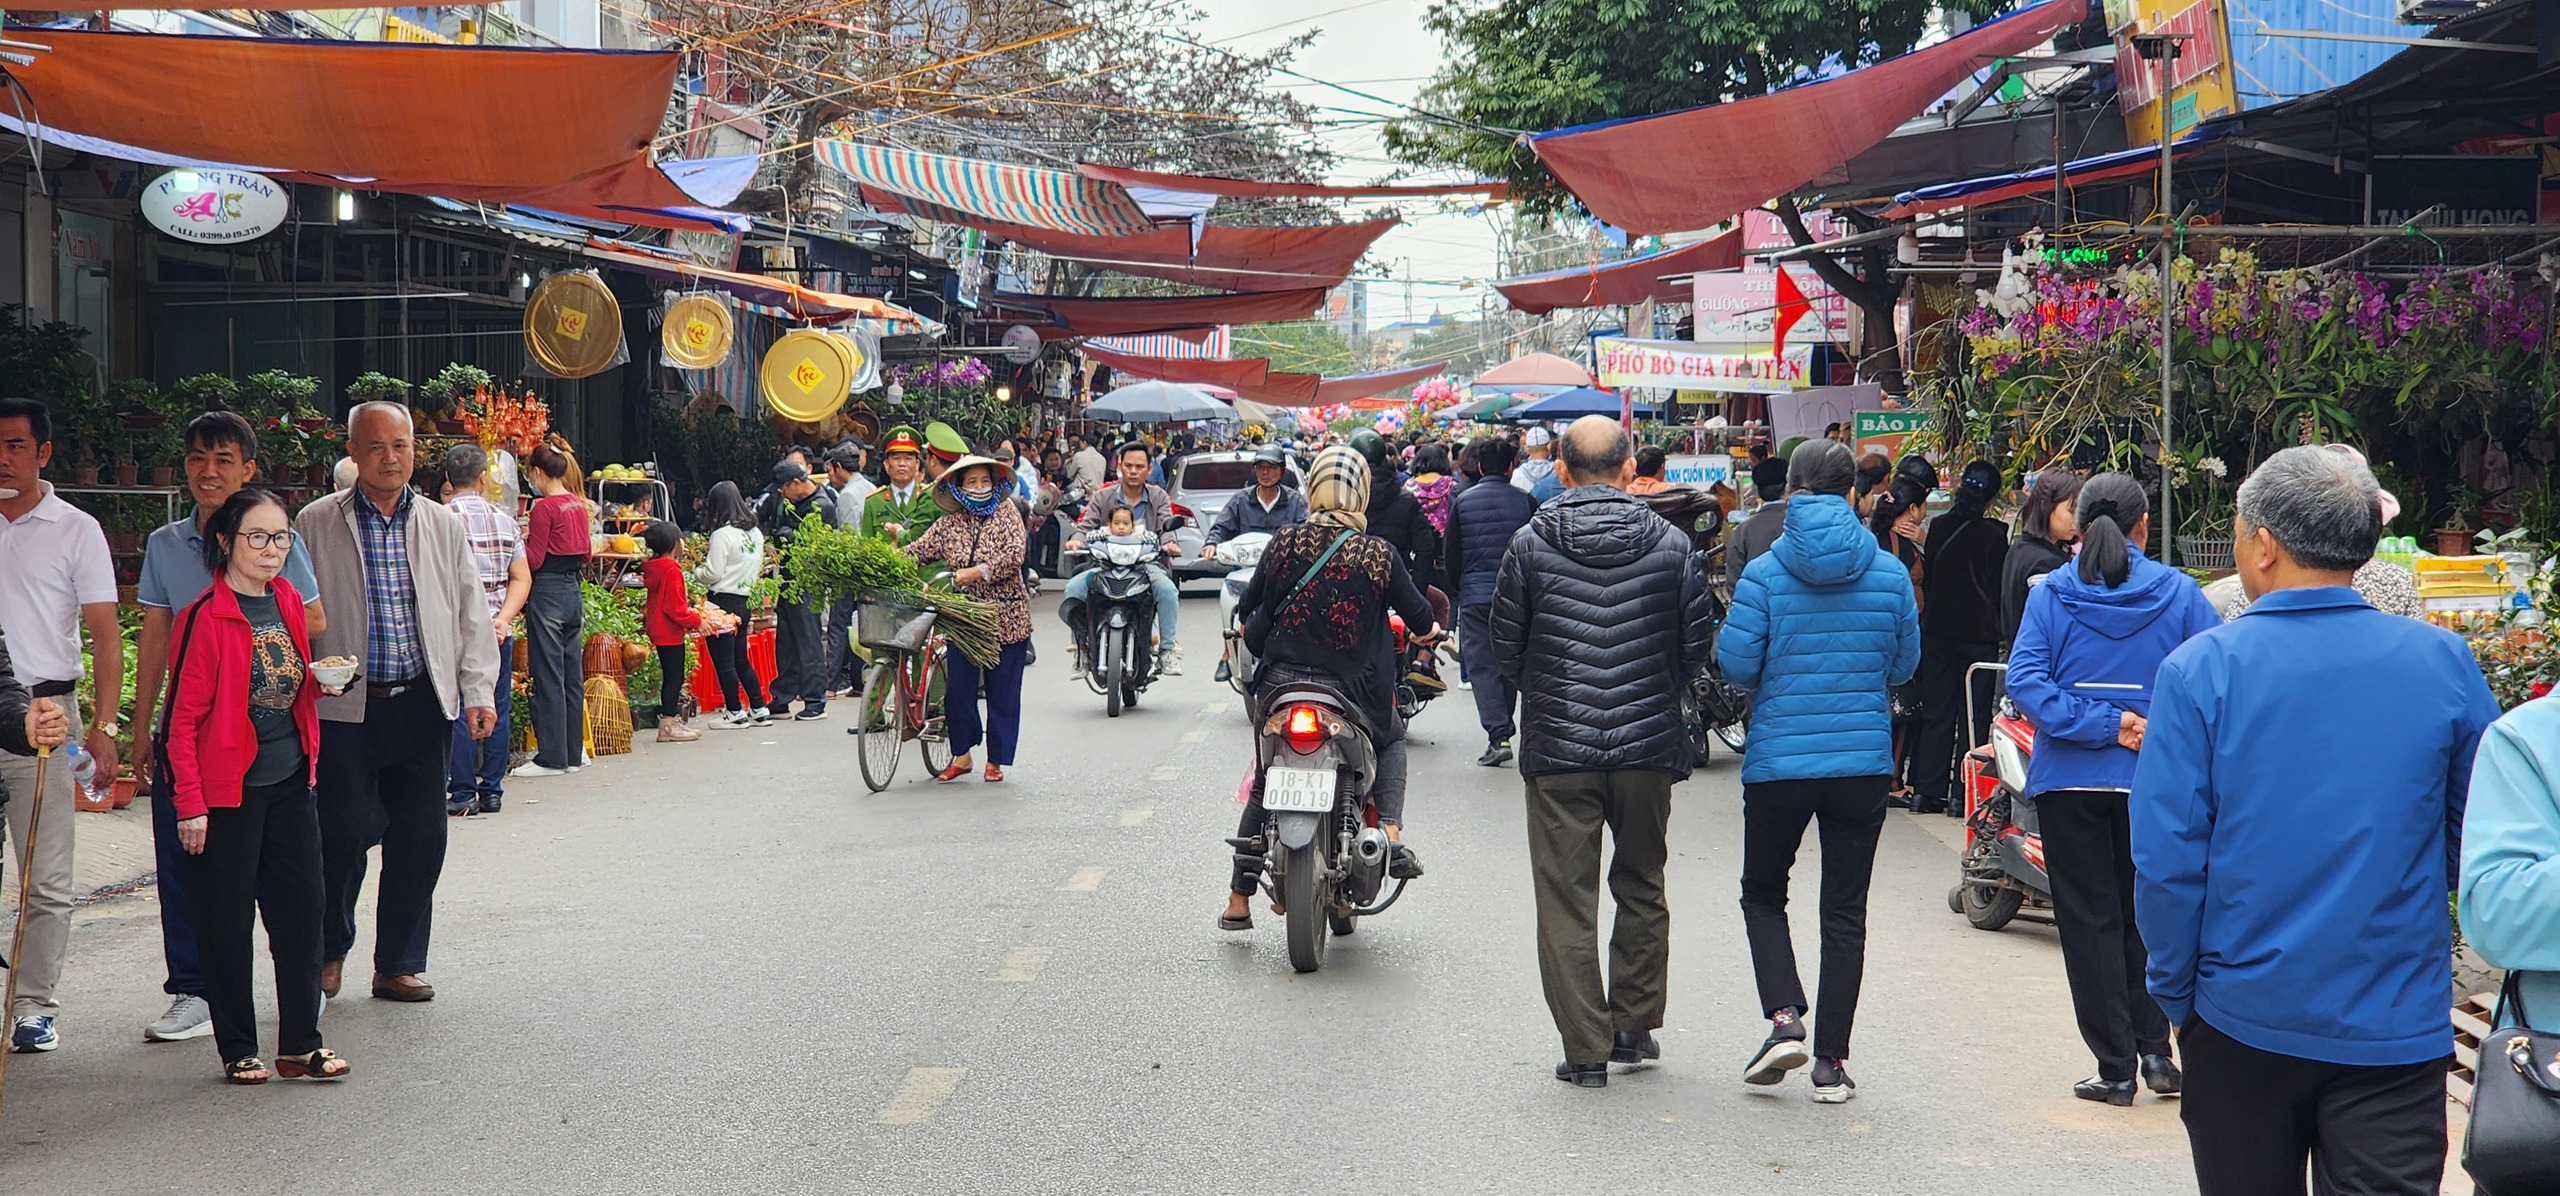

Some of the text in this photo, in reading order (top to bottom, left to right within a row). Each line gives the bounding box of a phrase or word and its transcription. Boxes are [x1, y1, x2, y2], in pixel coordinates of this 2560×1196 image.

[1607, 348, 1645, 374] PHỞ
[1651, 351, 1676, 376] BÒ
[1681, 357, 1714, 377] GIA
[1862, 415, 1904, 431] BẢO
[1280, 771, 1324, 788] 18-K1
[1269, 789, 1329, 807] 000.19
